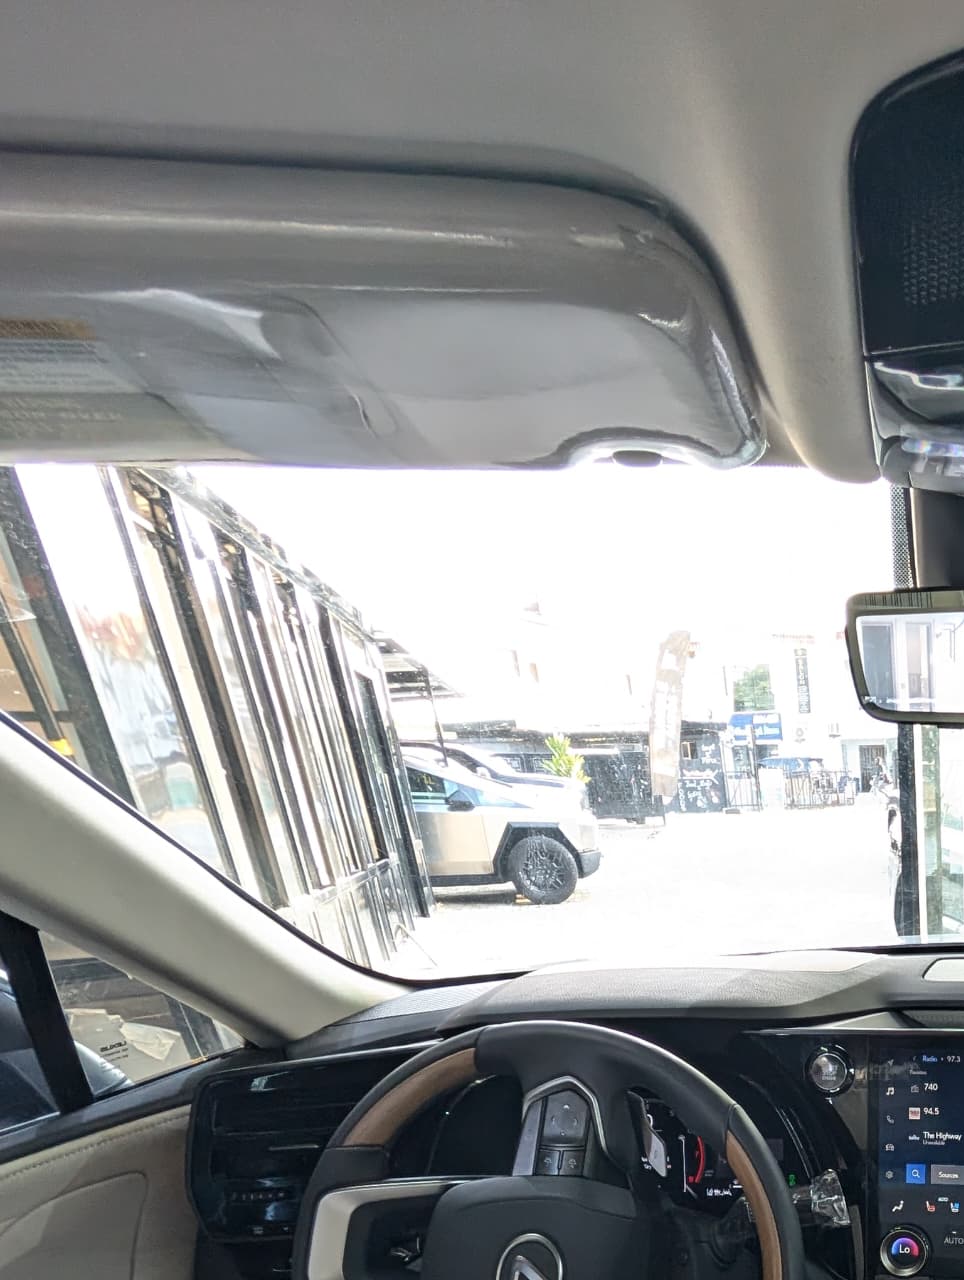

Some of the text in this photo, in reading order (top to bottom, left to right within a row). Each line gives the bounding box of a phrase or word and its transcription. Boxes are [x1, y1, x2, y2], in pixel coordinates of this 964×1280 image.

[946, 1055, 961, 1063] 97.3
[924, 1083, 938, 1091] 740
[923, 1107, 939, 1116] 94.5
[922, 1131, 935, 1139] The
[935, 1132, 962, 1141] Highway
[943, 1236, 964, 1245] AUTO
[899, 1244, 911, 1254] Lo
